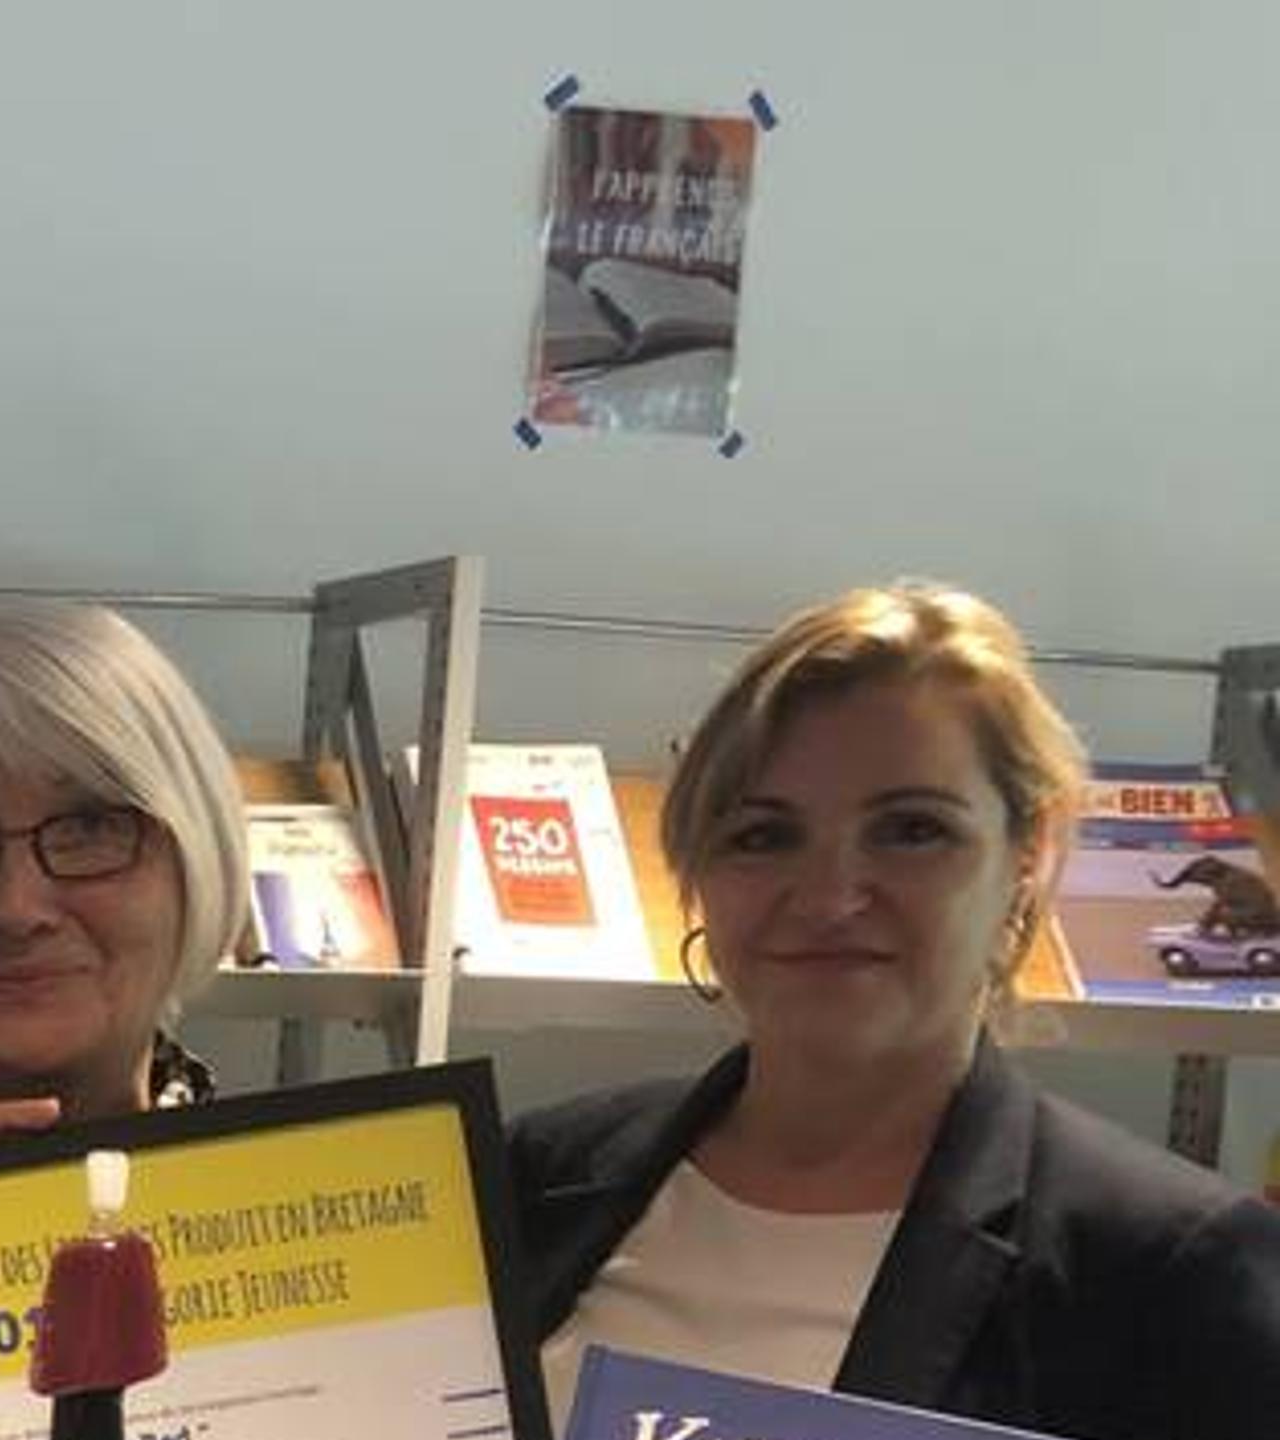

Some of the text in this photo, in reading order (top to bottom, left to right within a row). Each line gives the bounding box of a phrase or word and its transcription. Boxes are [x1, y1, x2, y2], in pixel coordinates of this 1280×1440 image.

[1121, 788, 1195, 815] BIEN
[489, 815, 570, 856] 250
[236, 1258, 350, 1320] JEUNESSE
